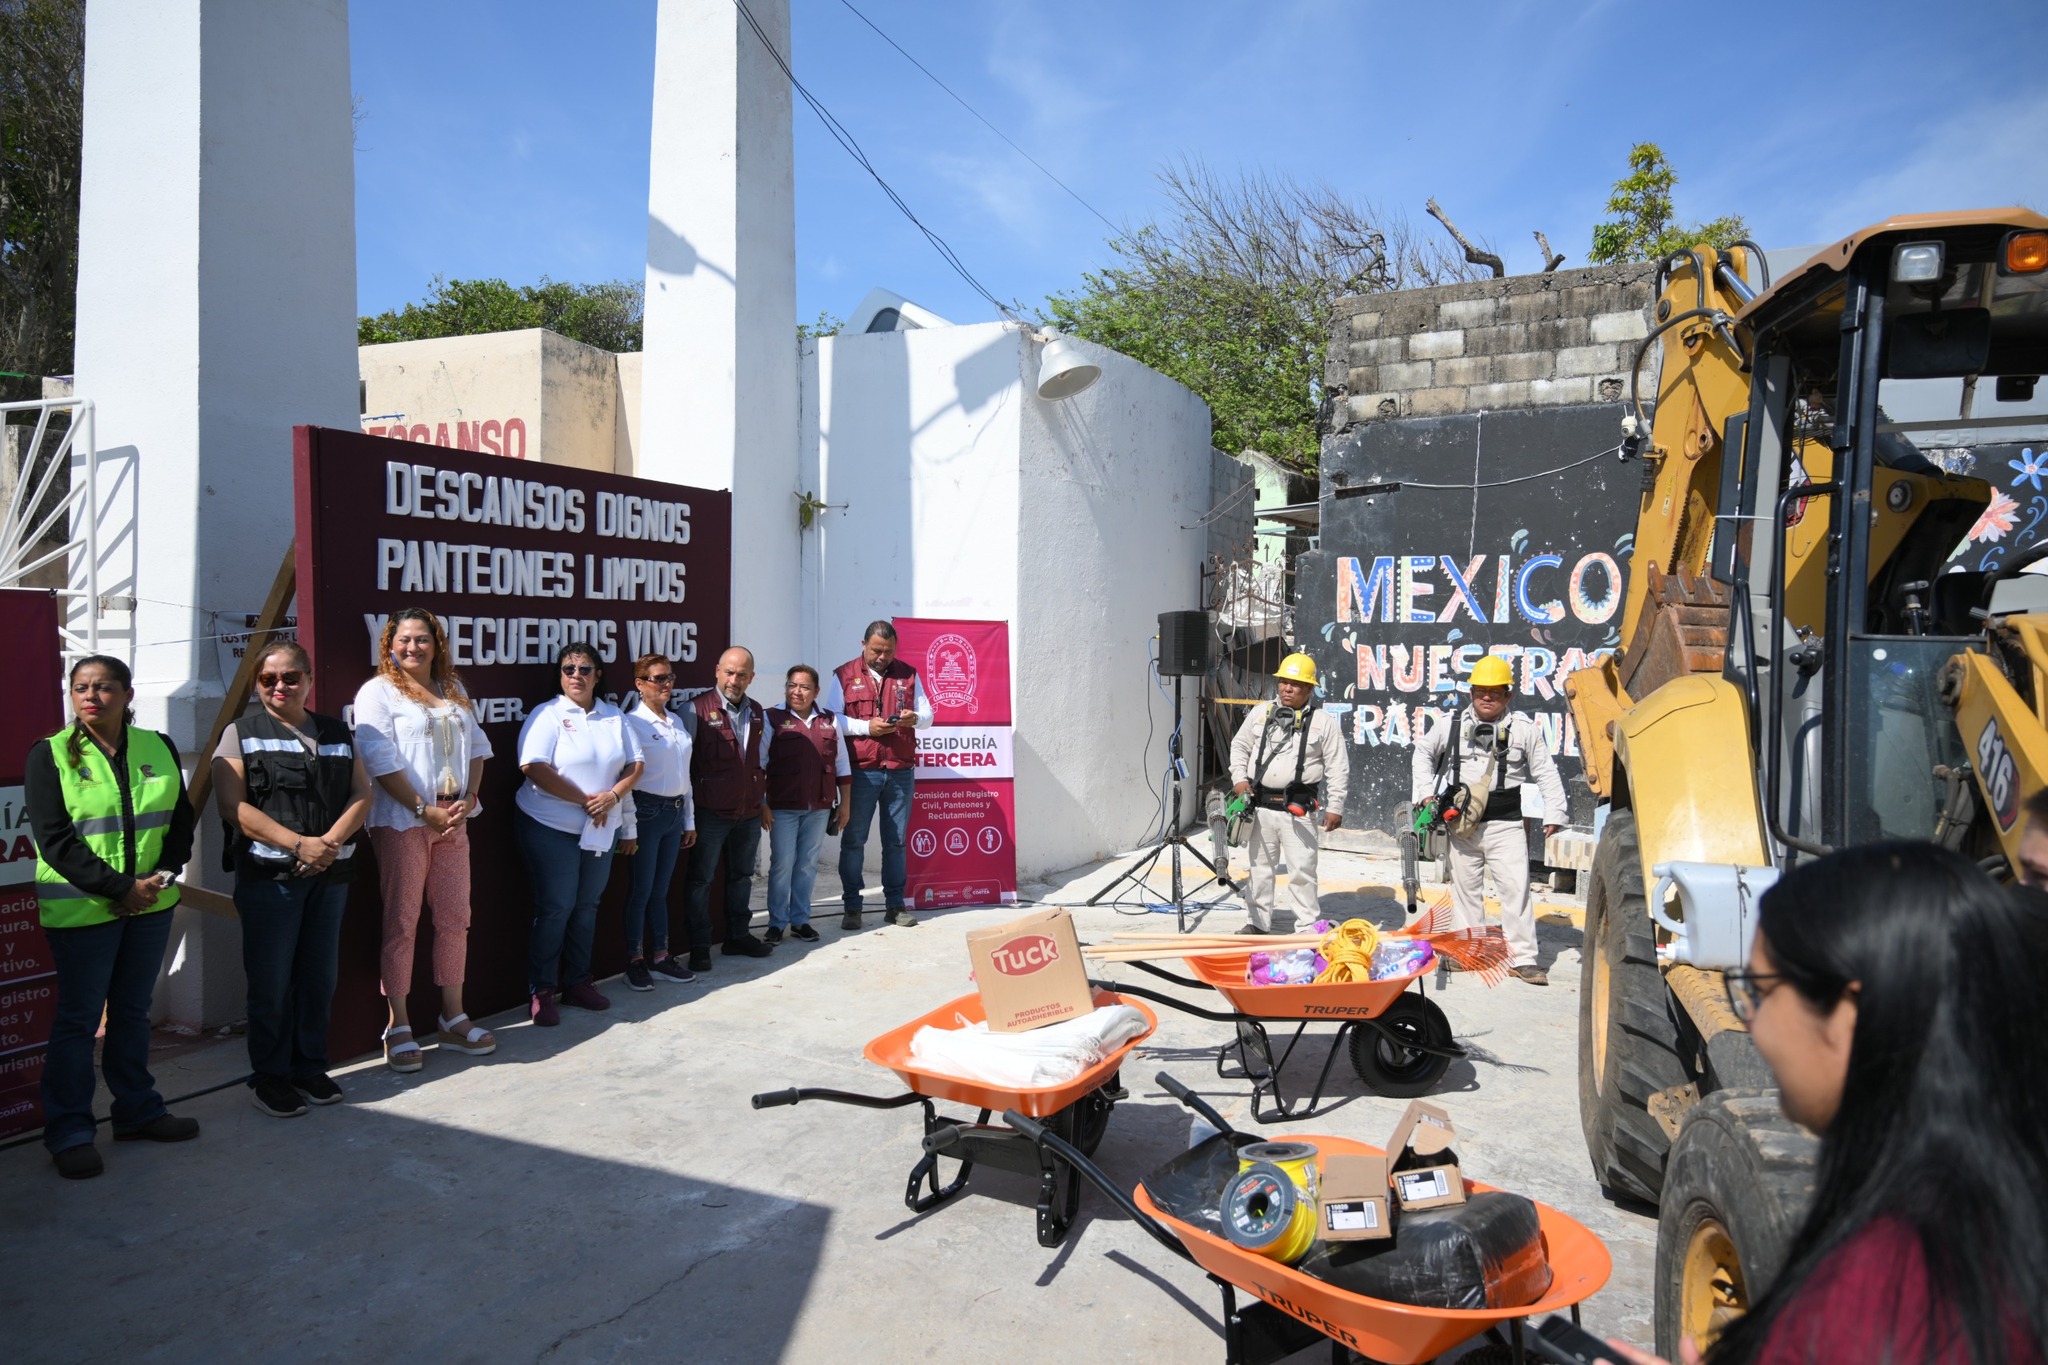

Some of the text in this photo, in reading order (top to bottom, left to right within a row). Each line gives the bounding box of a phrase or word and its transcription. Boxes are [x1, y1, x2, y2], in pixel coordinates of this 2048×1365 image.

[386, 461, 691, 544] DESCANSOS DIGNOS
[377, 538, 686, 604] PANTEONES LIMPIOS
[1337, 552, 1622, 624] MEXICO
[627, 620, 698, 663] VIVOS
[914, 734, 998, 750] REGIDURÍA
[914, 752, 997, 767] TERCERA
[1979, 720, 2012, 812] 416
[913, 790, 999, 800] Comisión del Registro
[921, 801, 991, 810] Civil, Panteones y
[928, 811, 985, 820] Reclutamiento
[5, 942, 15, 956] y
[992, 939, 1059, 973] Tuck
[23, 1010, 33, 1024] y
[1007, 1006, 1074, 1028] AUTOADHERIBLES
[1015, 1002, 1061, 1019] PRODUCTOS
[1304, 1005, 1369, 1015] TRUPER
[1251, 1280, 1360, 1349] TRUPER
